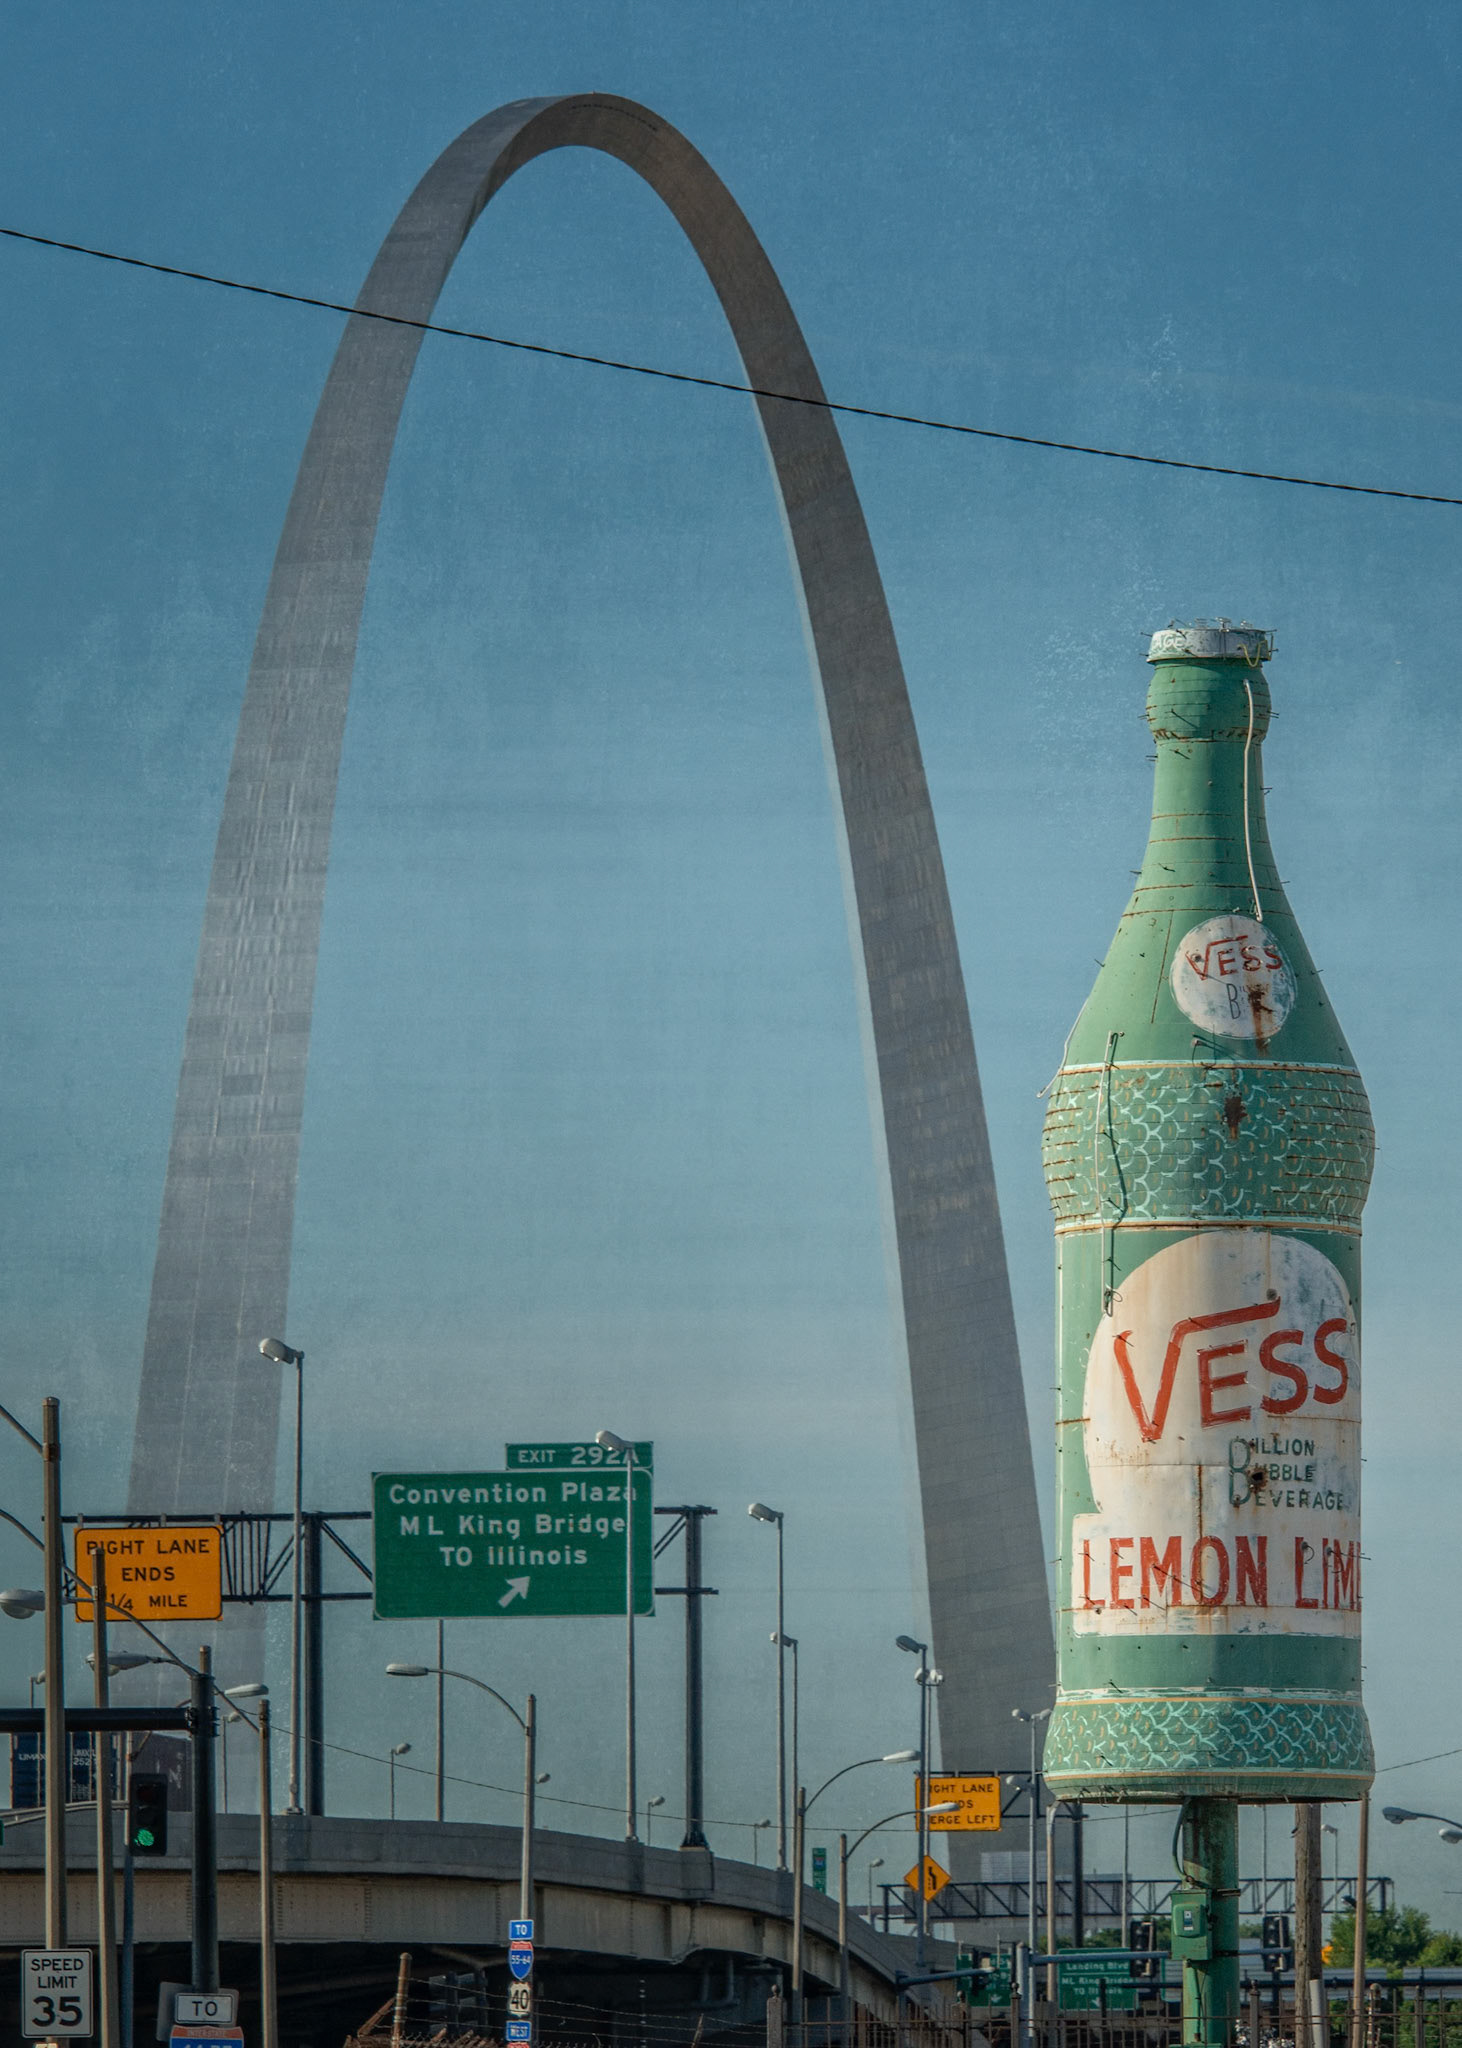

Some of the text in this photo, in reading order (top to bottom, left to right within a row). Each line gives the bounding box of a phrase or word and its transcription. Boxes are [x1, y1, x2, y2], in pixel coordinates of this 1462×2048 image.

[1185, 935, 1283, 981] VESS
[1113, 1297, 1348, 1442] VESS
[518, 1447, 639, 1465] EXIT 292A
[390, 1482, 636, 1504] Convention Plaza
[459, 1515, 520, 1539] King
[536, 1514, 626, 1538] Bridge
[157, 1539, 210, 1554] LANE
[440, 1546, 587, 1566] TO Illinois
[122, 1567, 175, 1581] ENDS
[1083, 1535, 1268, 1609] LEMON
[110, 1593, 188, 1610] 1/4 MILE
[928, 1784, 993, 1793] IGHT LANE
[930, 1815, 995, 1824] ERGE LEFT
[515, 1924, 528, 1935] TO
[31, 1958, 84, 1971] SPEED
[38, 1976, 77, 1989] LIMIT
[511, 1989, 529, 2010] 40
[32, 1995, 83, 2027] 35
[192, 2001, 217, 2016] TO
